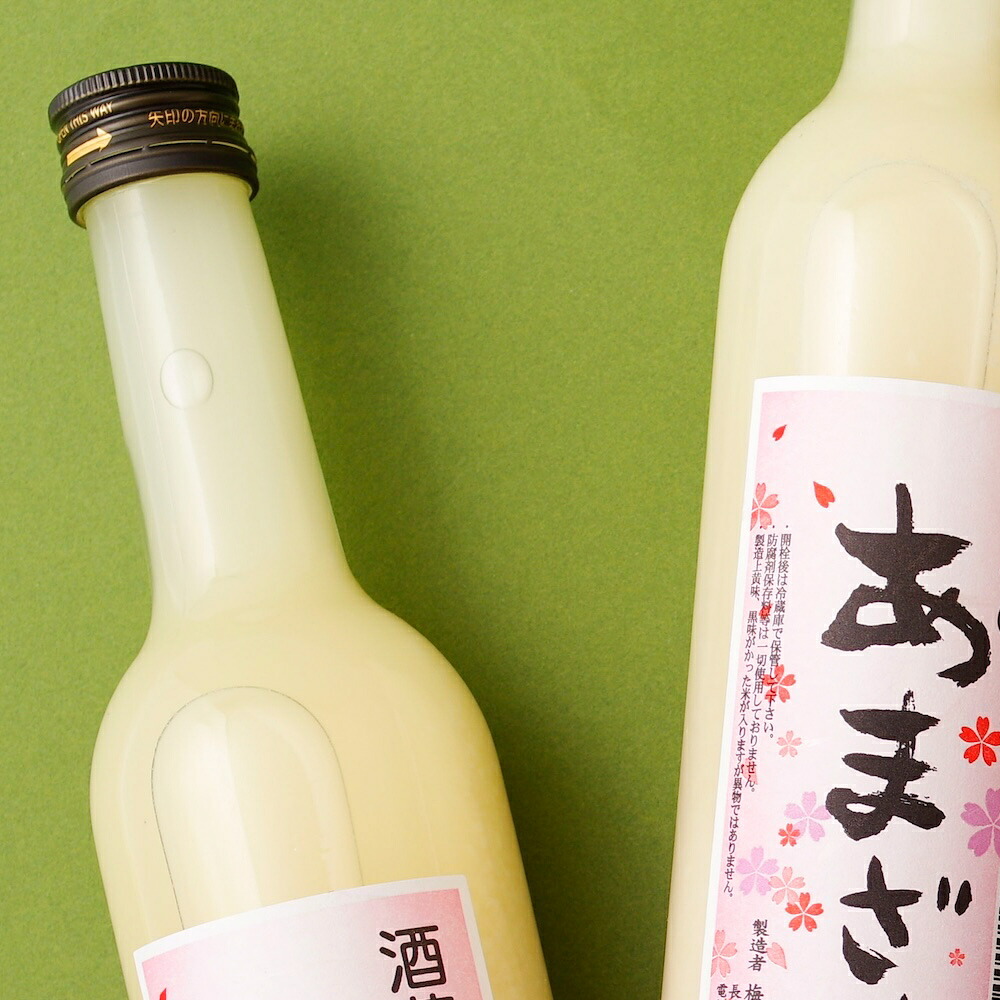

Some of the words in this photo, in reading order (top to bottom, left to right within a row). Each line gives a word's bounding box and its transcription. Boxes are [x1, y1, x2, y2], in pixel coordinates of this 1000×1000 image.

[89, 101, 113, 119] WAY
[747, 918, 770, 972] 製造者
